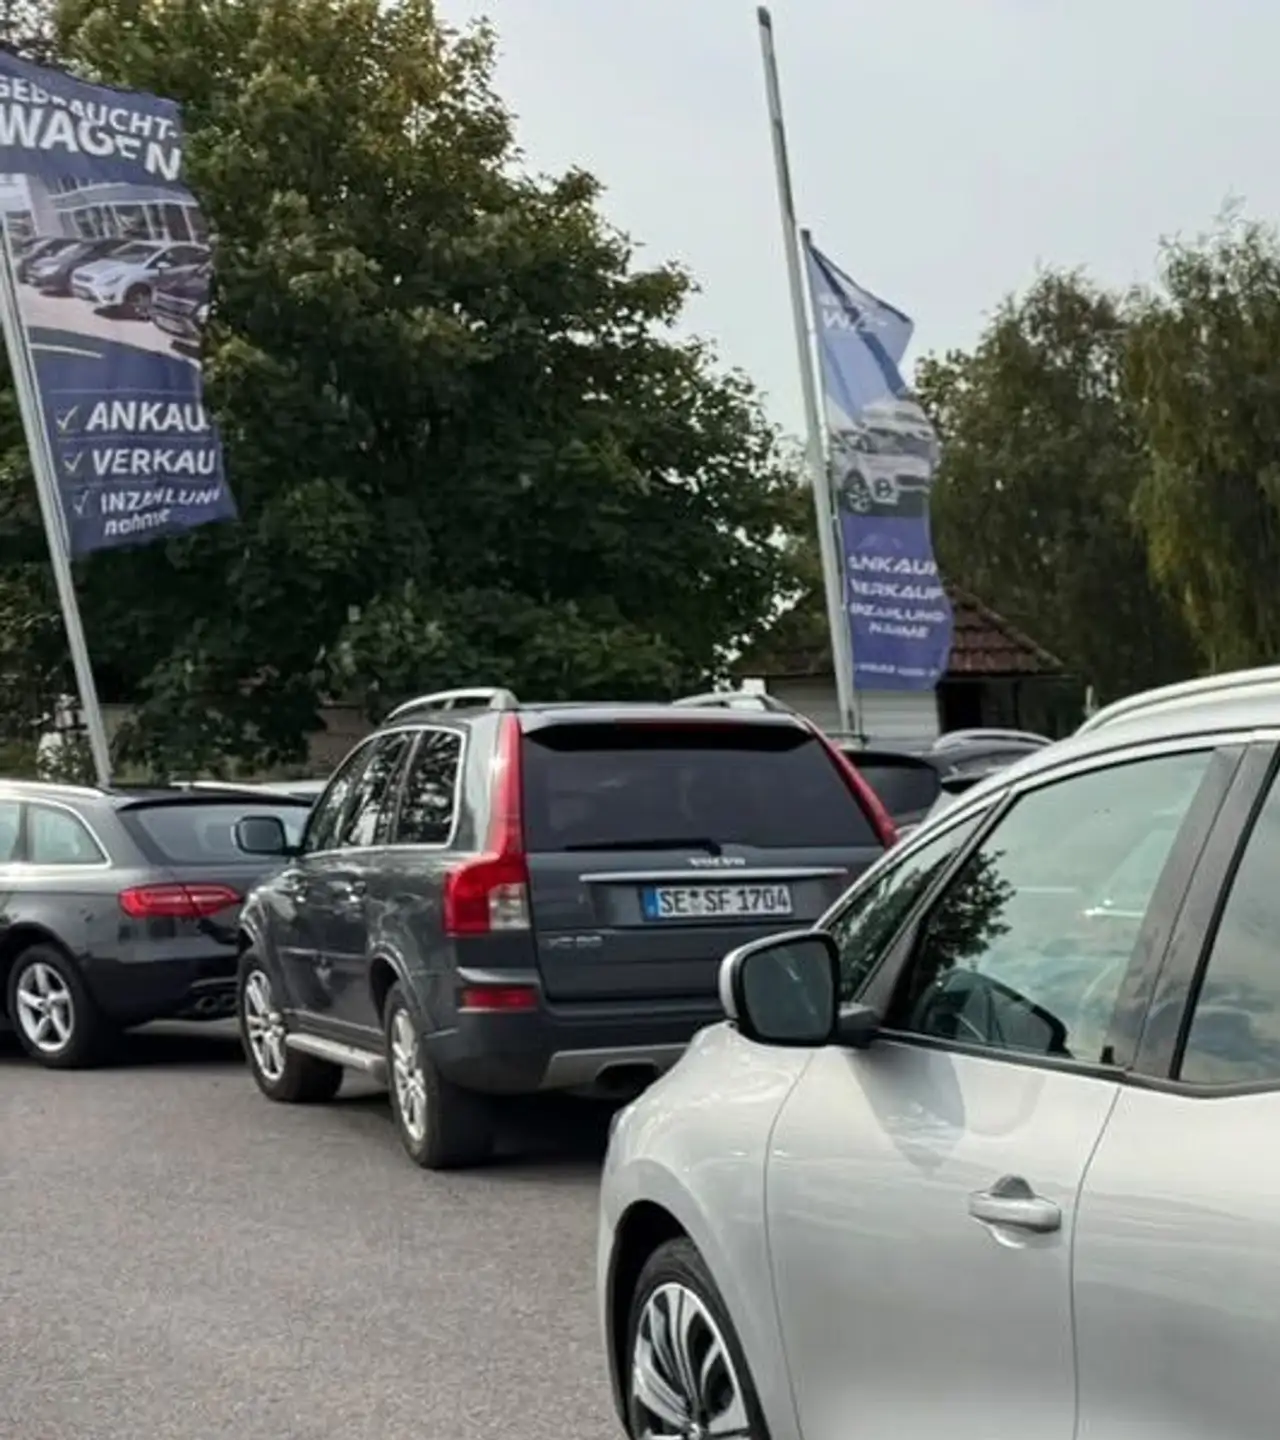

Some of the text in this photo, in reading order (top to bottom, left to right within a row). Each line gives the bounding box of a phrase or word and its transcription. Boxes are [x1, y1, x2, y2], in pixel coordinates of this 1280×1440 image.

[0, 102, 182, 182] WAGEN
[85, 400, 210, 432] ANKAU
[92, 447, 216, 477] VERKAU
[660, 886, 790, 914] SE SF 1704
